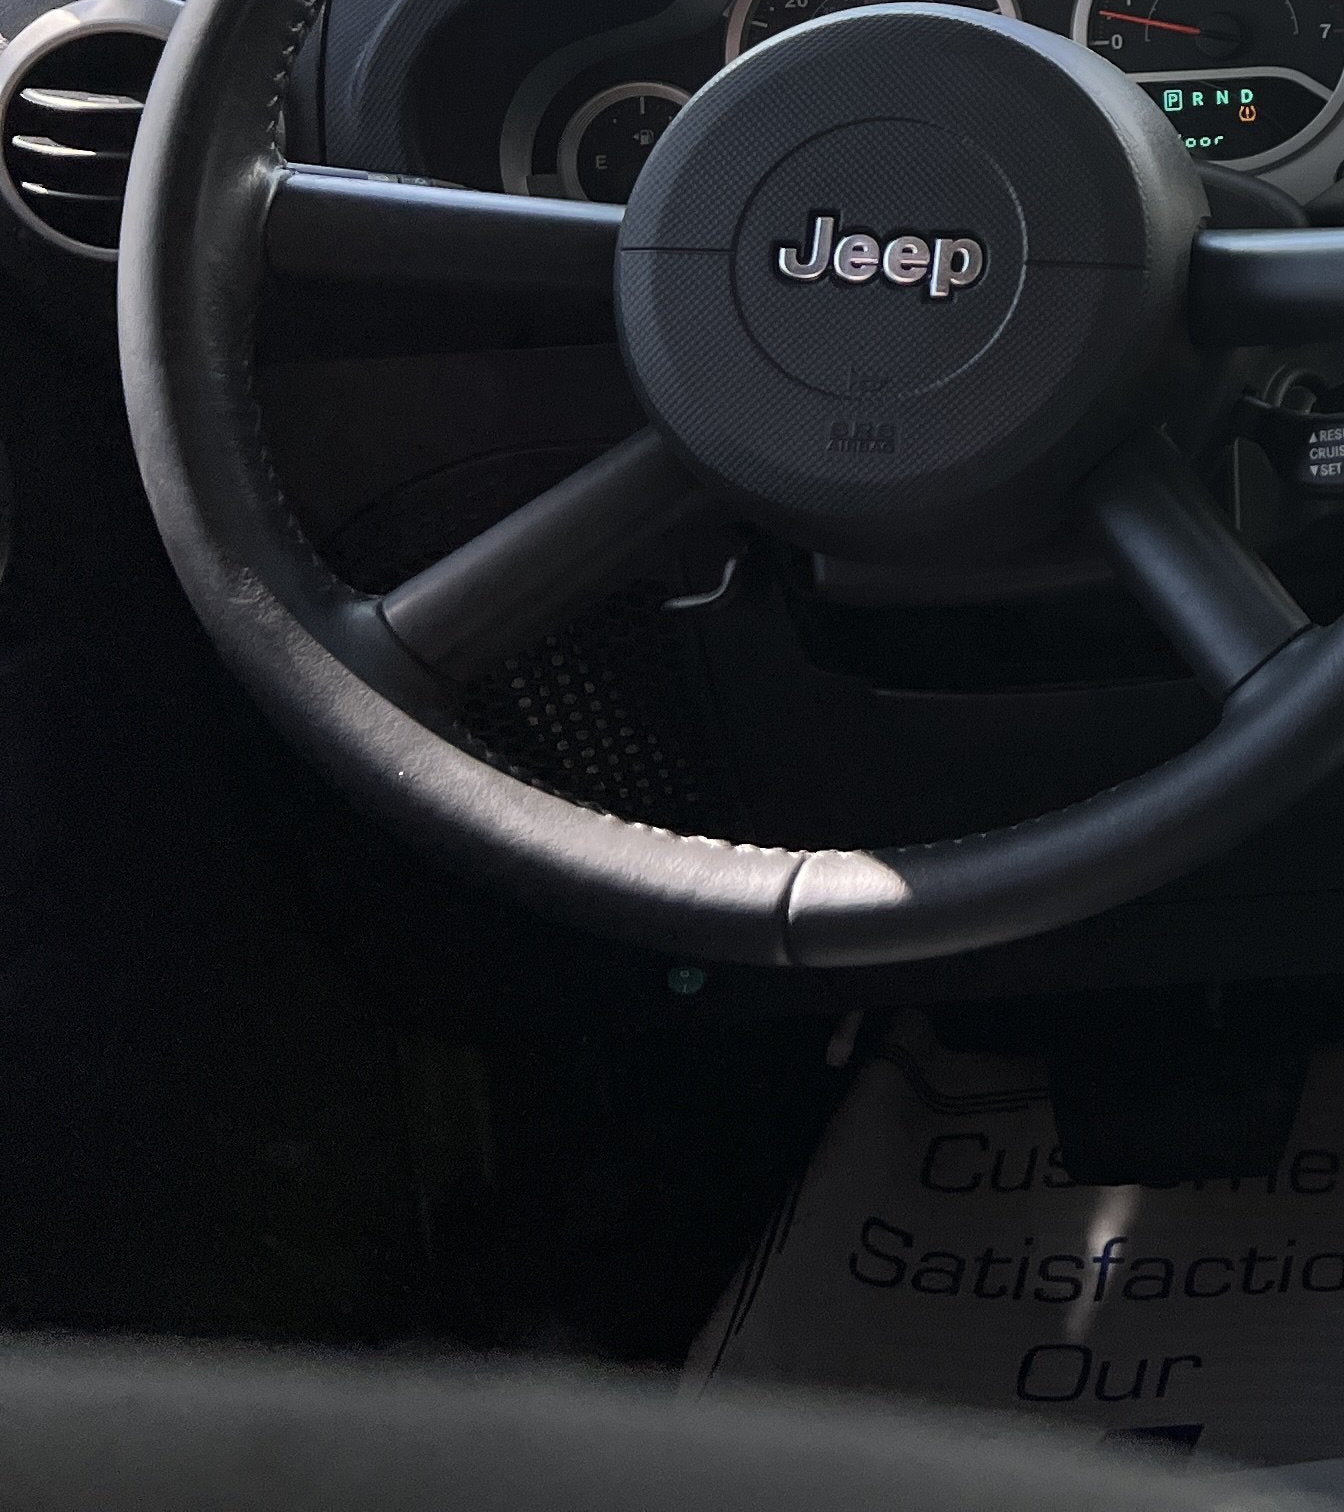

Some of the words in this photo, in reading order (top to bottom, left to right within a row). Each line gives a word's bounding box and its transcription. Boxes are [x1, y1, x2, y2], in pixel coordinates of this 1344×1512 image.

[1111, 34, 1123, 49] 0
[1320, 24, 1331, 38] 7
[1167, 93, 1179, 107] P
[1192, 92, 1204, 106] R
[1216, 90, 1229, 105] N
[1240, 89, 1254, 104] D
[595, 154, 608, 169] E
[778, 216, 983, 297] Jeep
[1320, 462, 1342, 476] SET
[1016, 1344, 1203, 1402] Our
